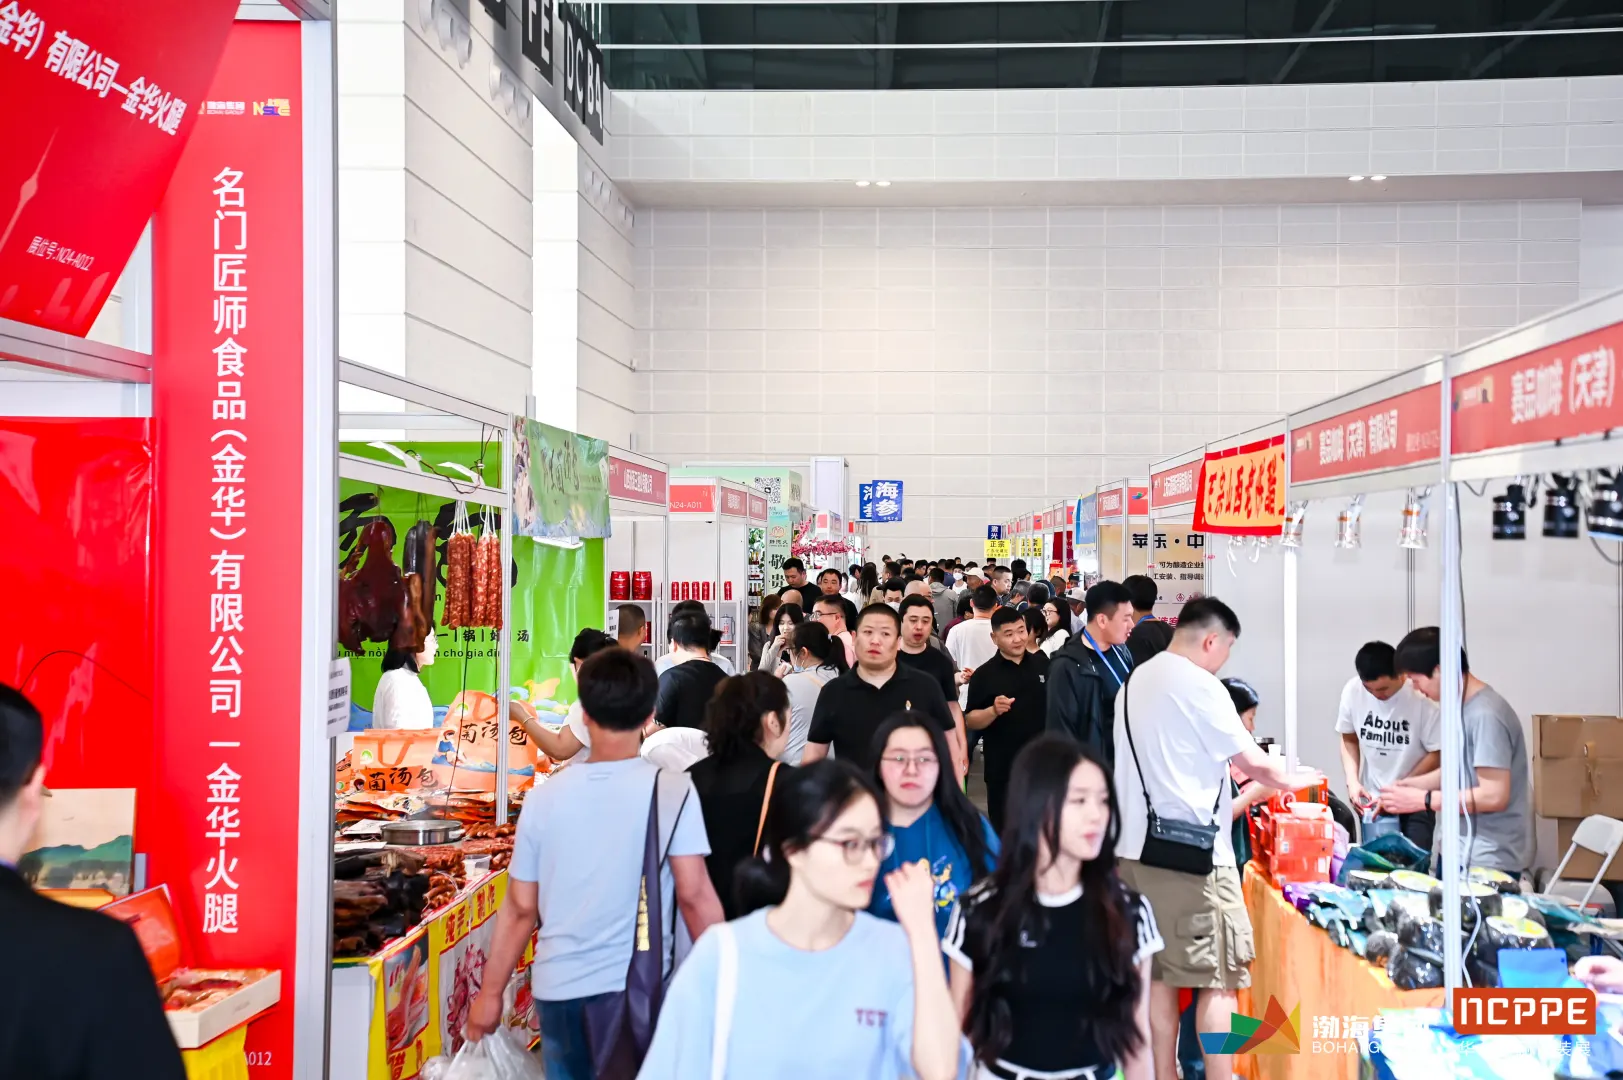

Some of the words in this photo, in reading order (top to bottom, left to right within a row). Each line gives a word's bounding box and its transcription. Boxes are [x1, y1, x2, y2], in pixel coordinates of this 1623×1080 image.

[875, 481, 899, 516] 海参
[443, 649, 464, 657] cho
[1363, 710, 1410, 732] About
